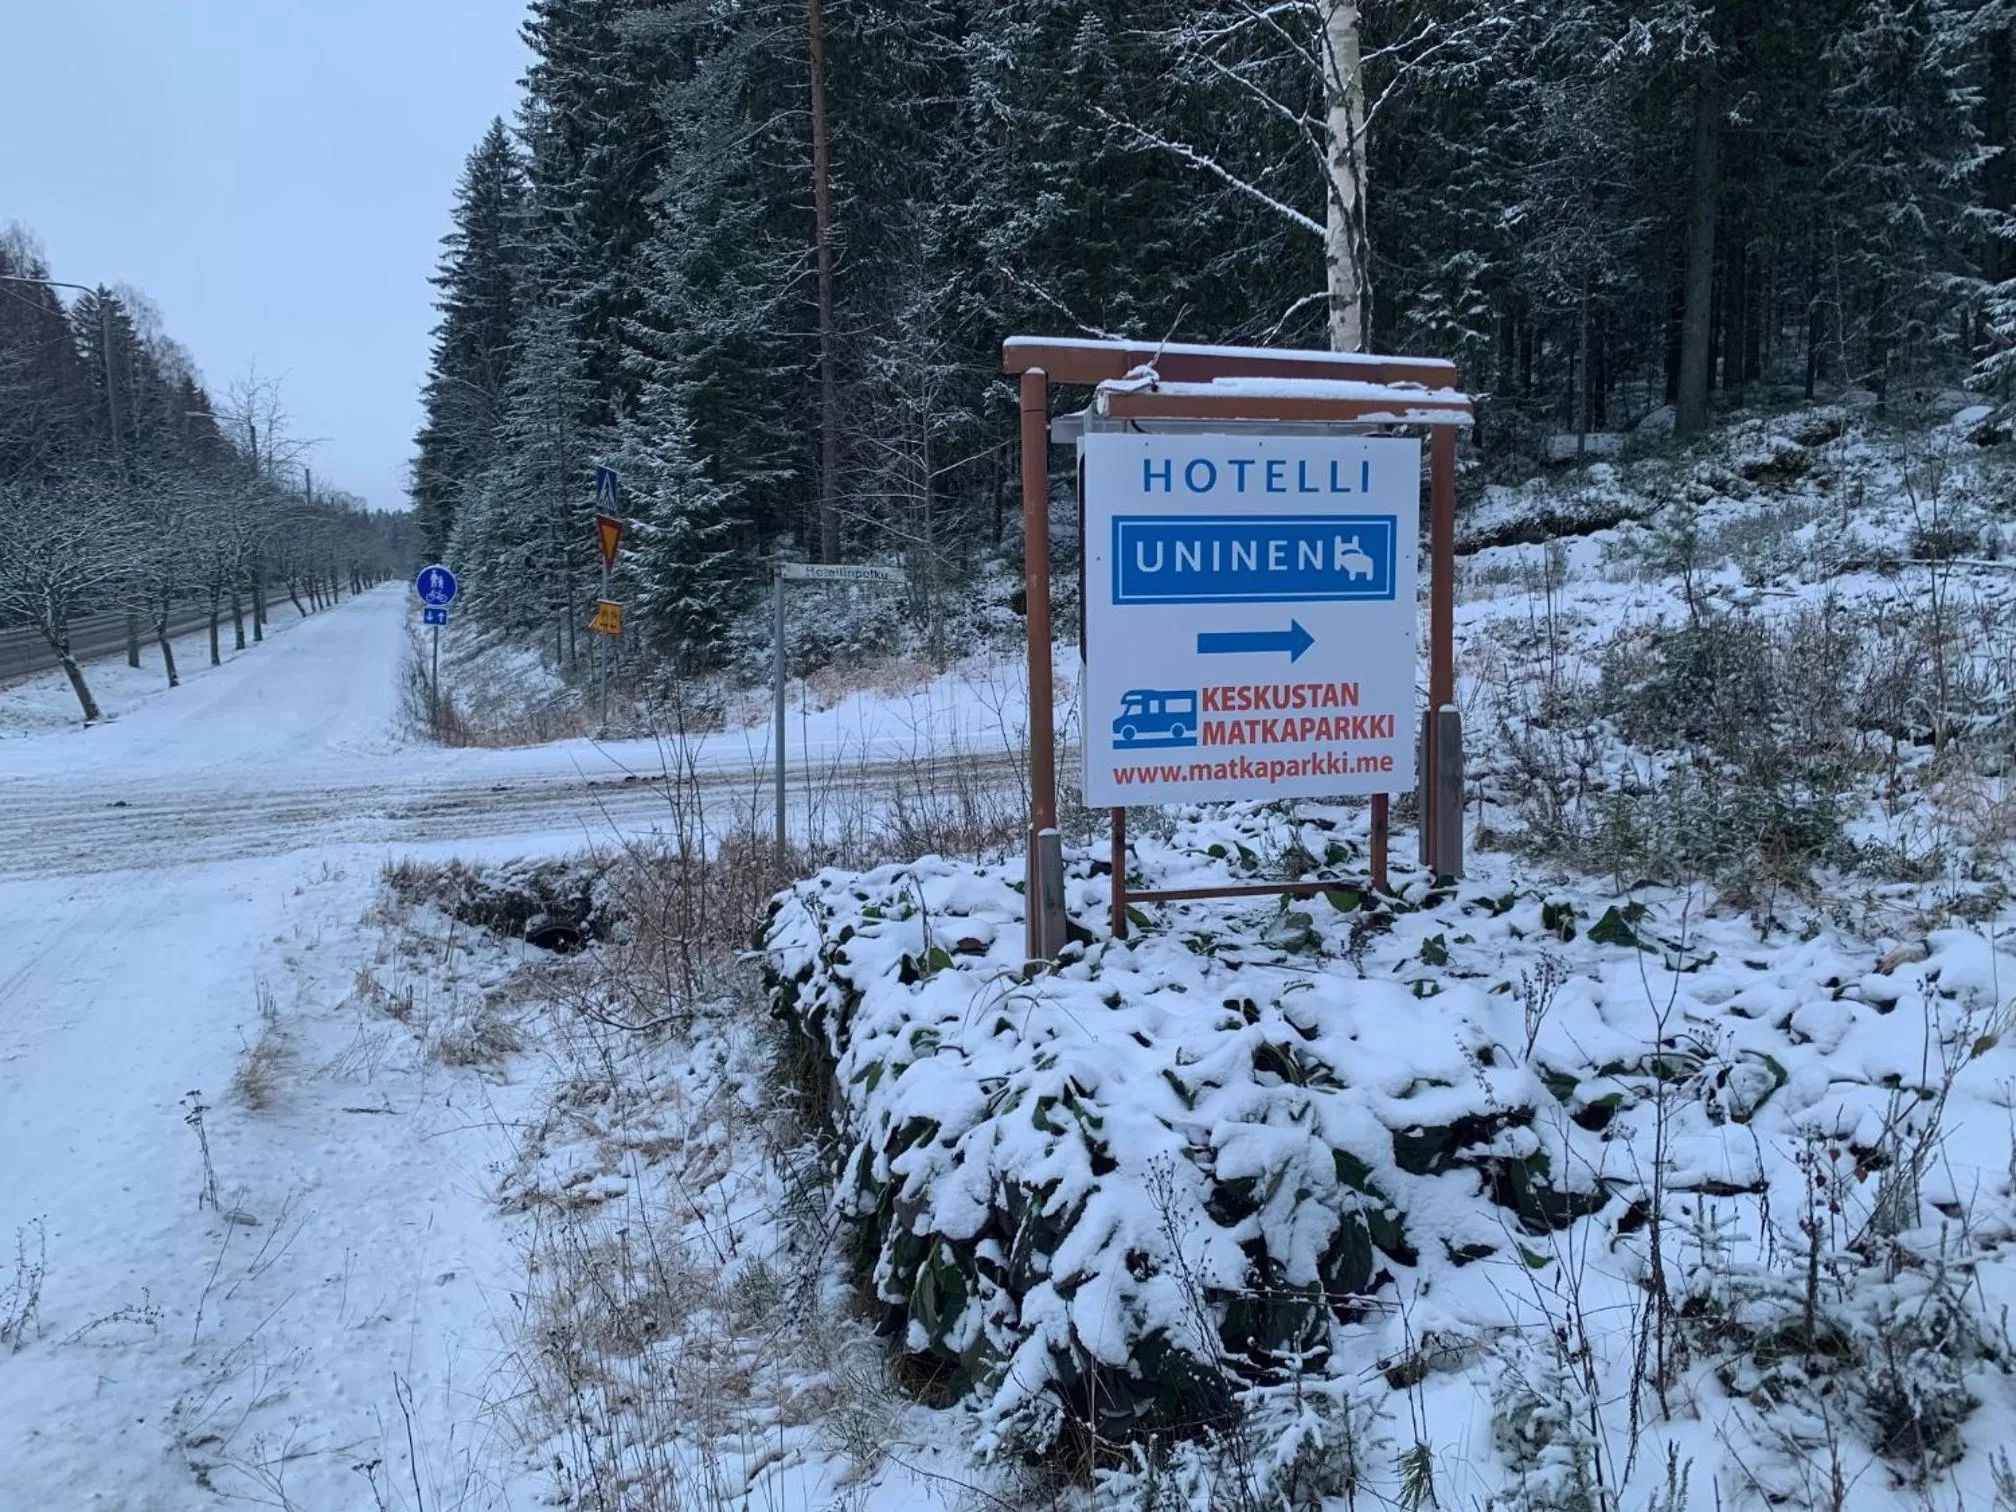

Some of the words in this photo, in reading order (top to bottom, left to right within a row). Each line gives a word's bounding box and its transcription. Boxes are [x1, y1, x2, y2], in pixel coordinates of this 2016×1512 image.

[1143, 459, 1370, 493] HOTELLI
[1136, 540, 1324, 573] UNINEN
[1202, 682, 1360, 712] KESKUSTAN
[1202, 714, 1395, 747] MATKAPARKKI
[1113, 751, 1394, 785] www.matkaparkki.me
